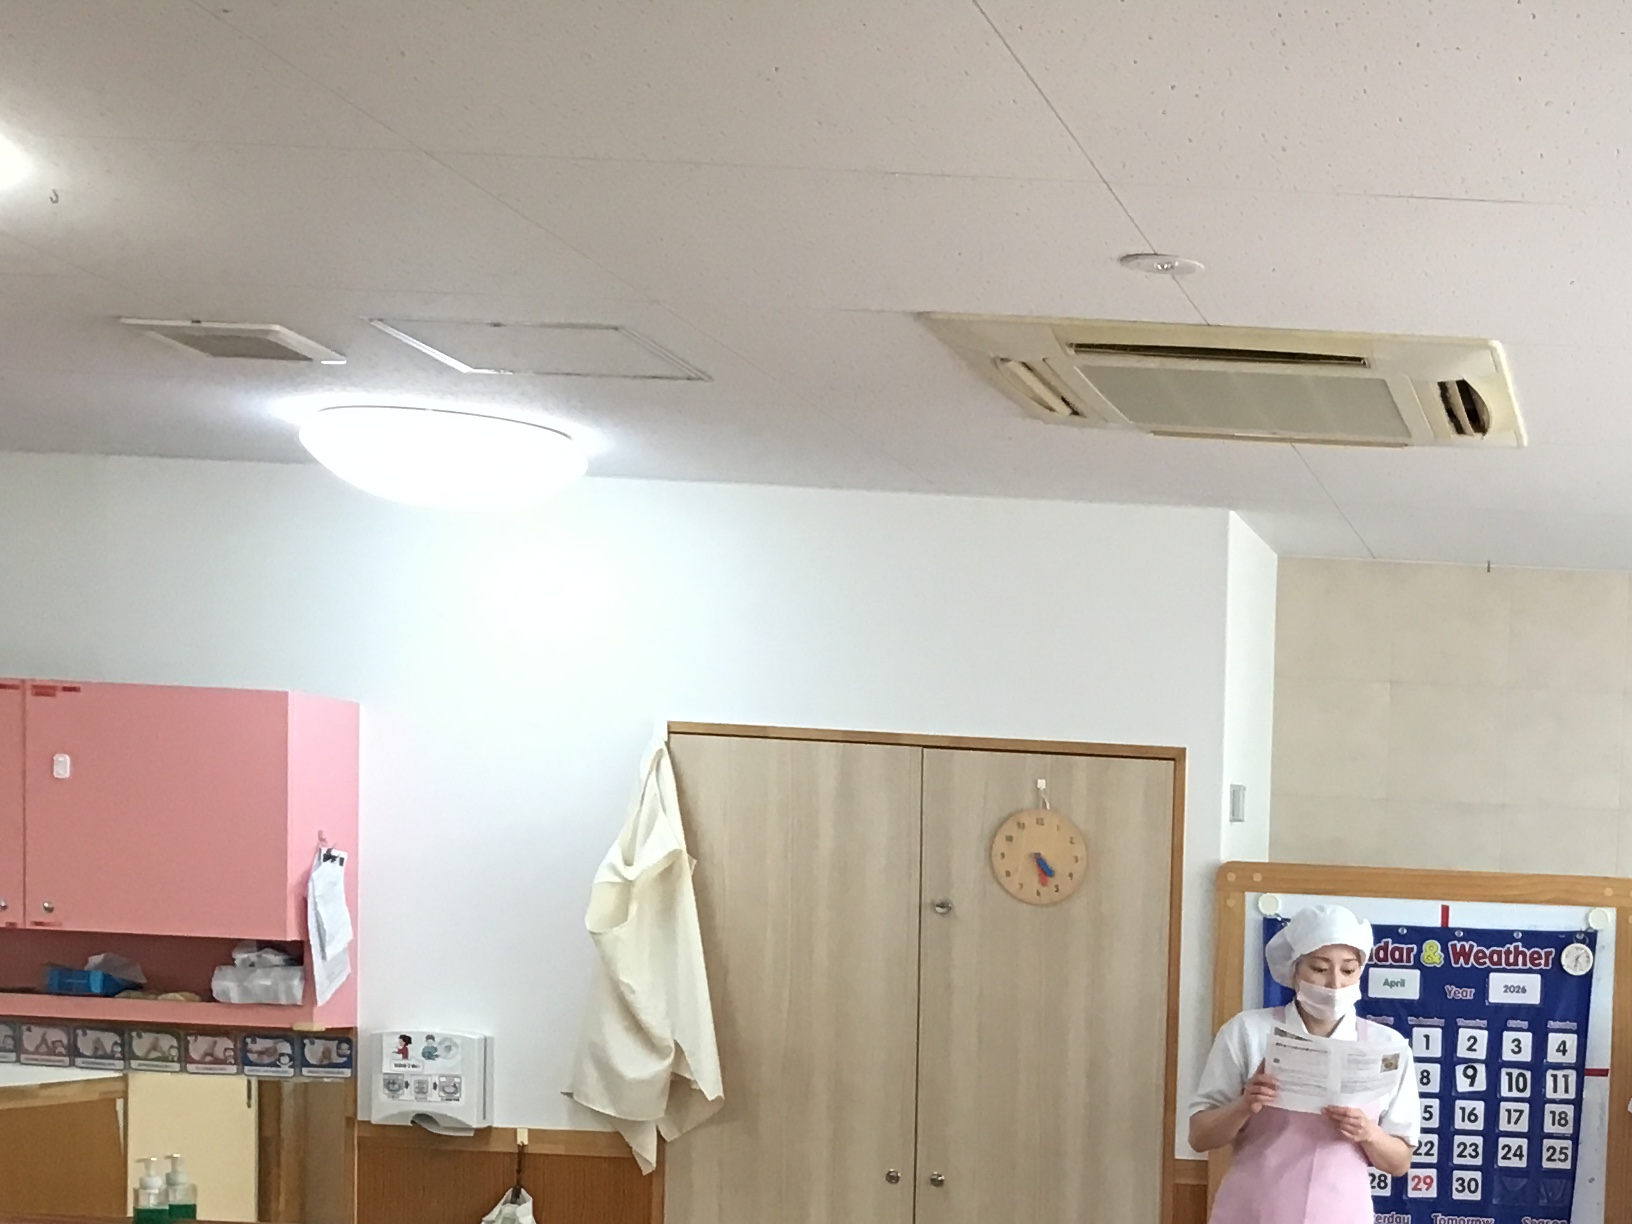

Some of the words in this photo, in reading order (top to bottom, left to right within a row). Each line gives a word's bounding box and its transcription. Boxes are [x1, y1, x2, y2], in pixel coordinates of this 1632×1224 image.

[1420, 940, 1445, 966] &
[1449, 941, 1555, 970] Weather
[1382, 977, 1406, 989] April
[1445, 985, 1475, 1000] Year
[1502, 984, 1528, 995] 2026
[1422, 1034, 1430, 1050] 1
[1466, 1035, 1478, 1052] 2
[1510, 1037, 1523, 1055] 3
[1555, 1039, 1569, 1056] 4
[1419, 1069, 1431, 1086] 8
[1462, 1064, 1478, 1087] 9
[1505, 1071, 1528, 1093] 10
[1550, 1073, 1570, 1094] 11
[1421, 1104, 1434, 1121] 5
[1458, 1106, 1479, 1124] 16
[1504, 1108, 1525, 1125] 17
[1549, 1110, 1569, 1127] 18
[1412, 1140, 1435, 1157] 22
[1456, 1141, 1480, 1159] 23
[1500, 1143, 1525, 1161] 24
[1545, 1145, 1569, 1163] 25
[1369, 1172, 1388, 1190] 28
[1411, 1174, 1434, 1191] 29
[1454, 1176, 1479, 1194] 30
